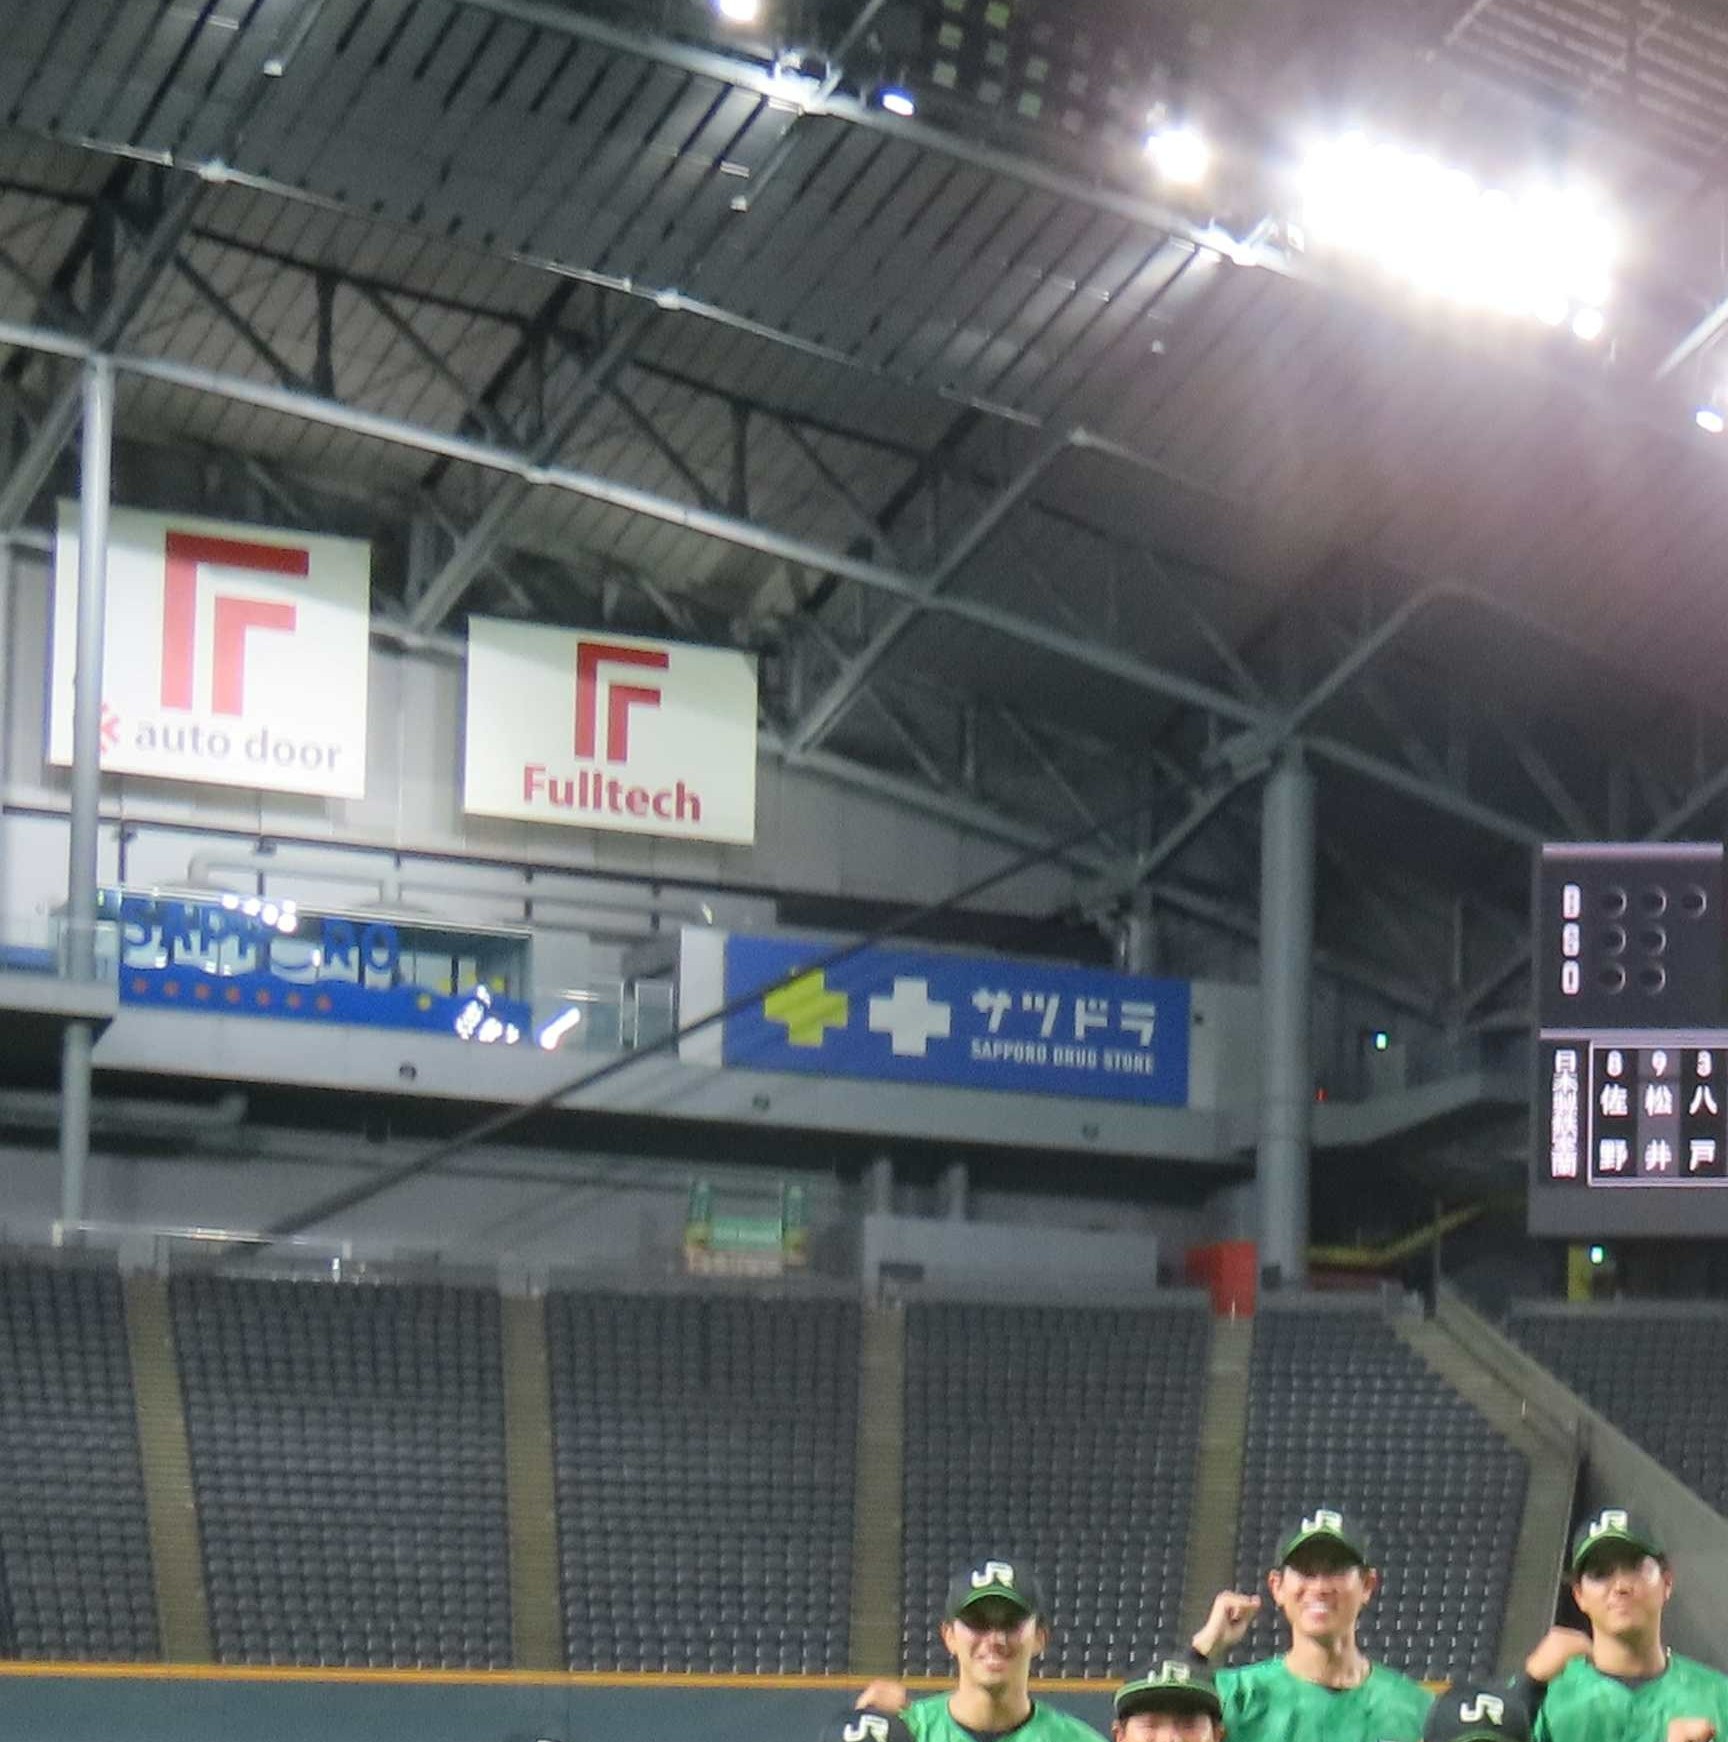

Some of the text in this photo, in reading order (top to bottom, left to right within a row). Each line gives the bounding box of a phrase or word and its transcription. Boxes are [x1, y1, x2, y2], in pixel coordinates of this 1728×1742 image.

[135, 722, 231, 757] auto
[245, 727, 342, 771] door
[524, 764, 701, 822] Fulltech
[971, 987, 1156, 1047] サツドラ
[971, 1038, 1154, 1076] SAPPORO DRUG STORE
[1607, 1050, 1623, 1077] 8
[1651, 1050, 1668, 1077] 9
[1696, 1050, 1712, 1077] 3
[1302, 1509, 1343, 1534] JR
[1589, 1509, 1628, 1537] JR
[972, 1561, 1015, 1589] JR
[1460, 1693, 1504, 1725] JR
